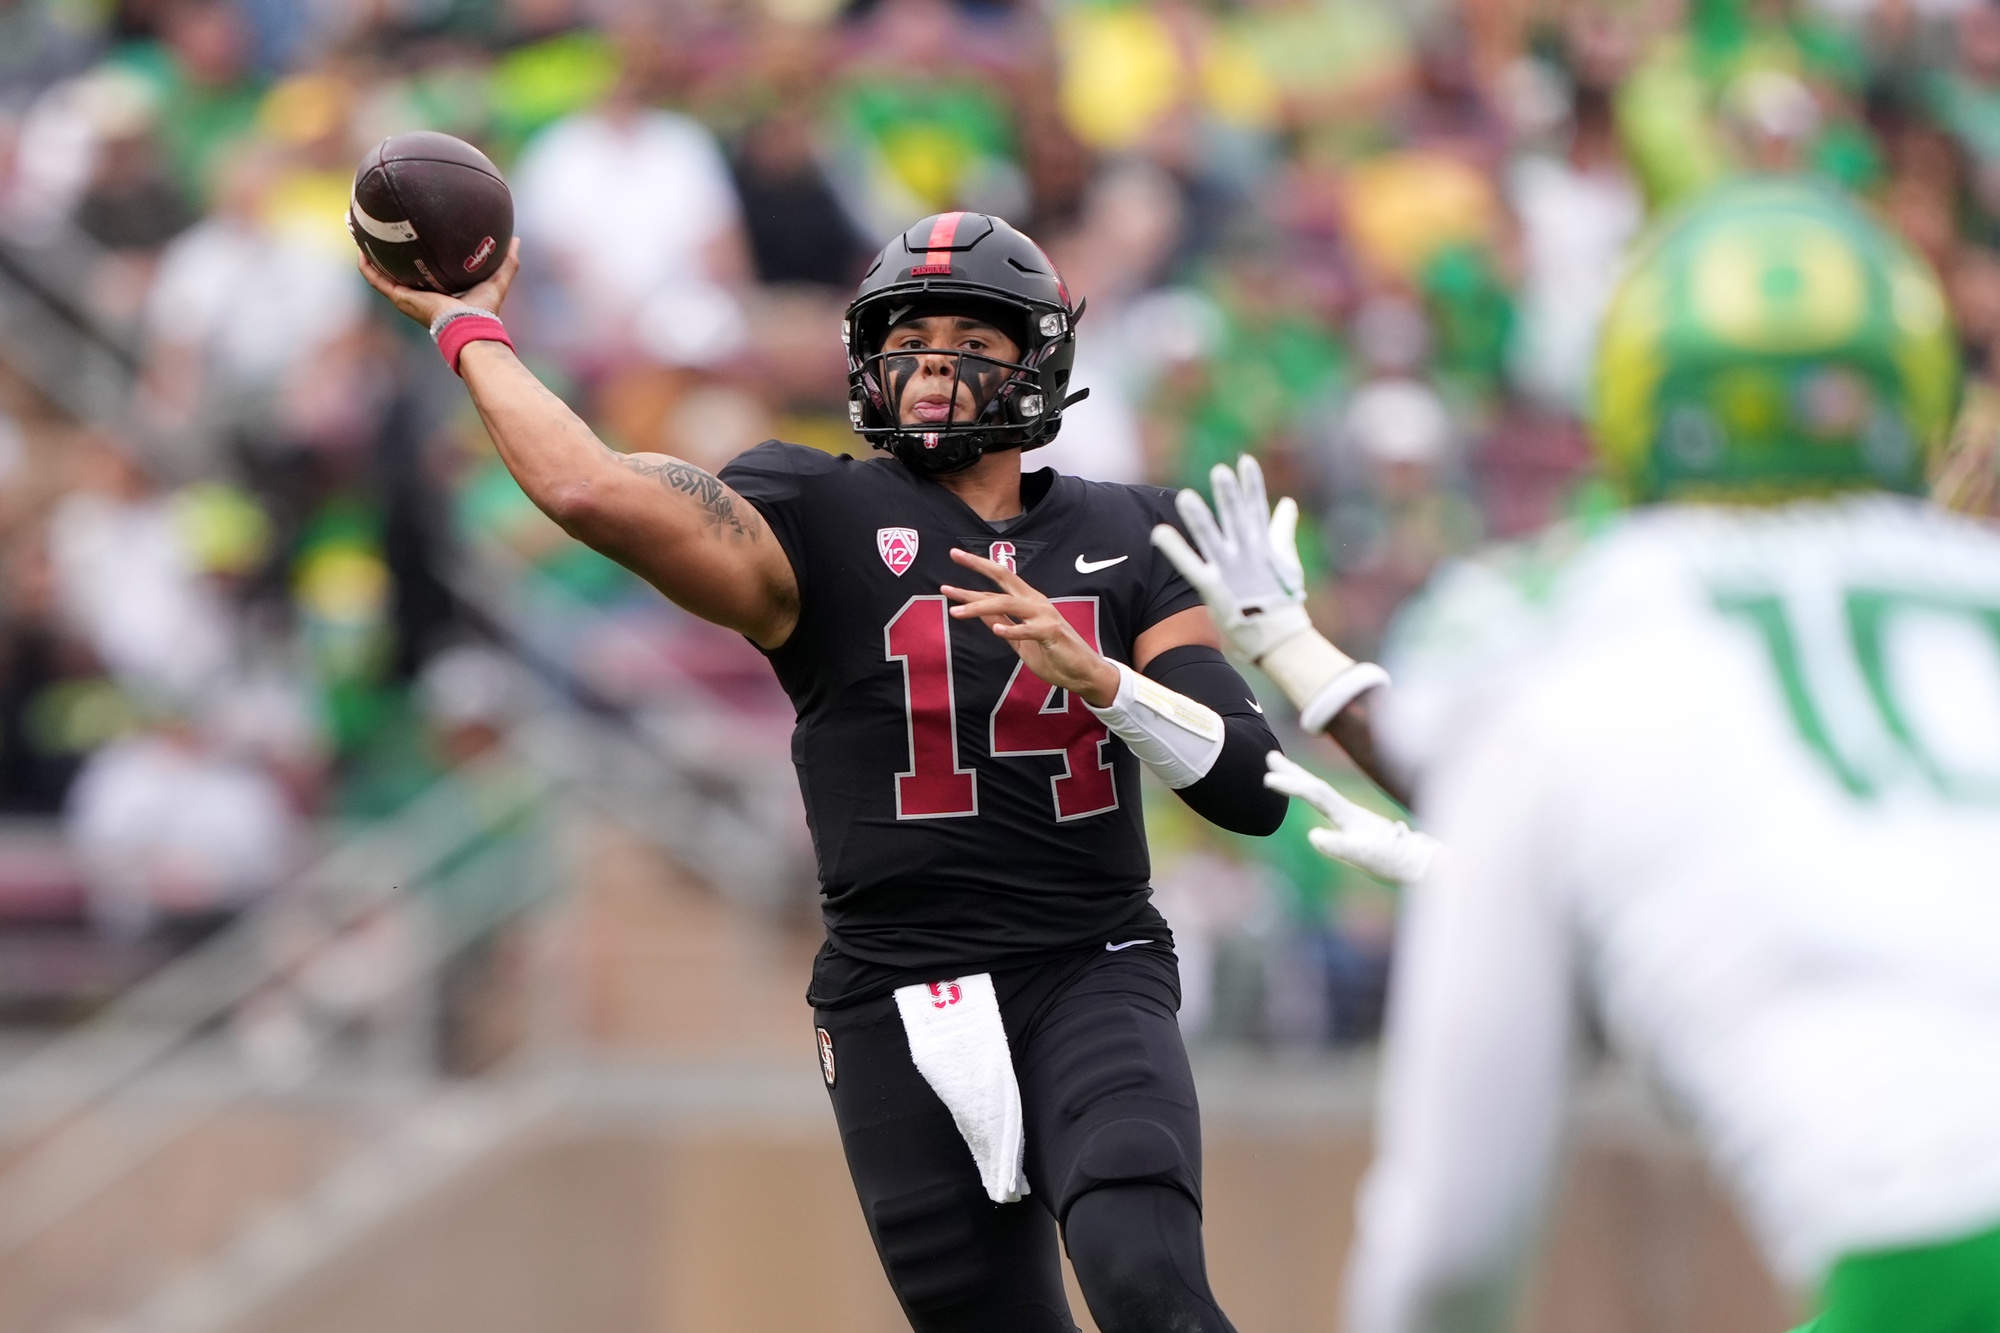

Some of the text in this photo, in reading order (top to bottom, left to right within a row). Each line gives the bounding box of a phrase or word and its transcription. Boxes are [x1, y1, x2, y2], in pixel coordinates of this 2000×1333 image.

[911, 265, 952, 276] CARDINAL
[889, 548, 909, 565] 12
[884, 594, 1119, 822] 14
